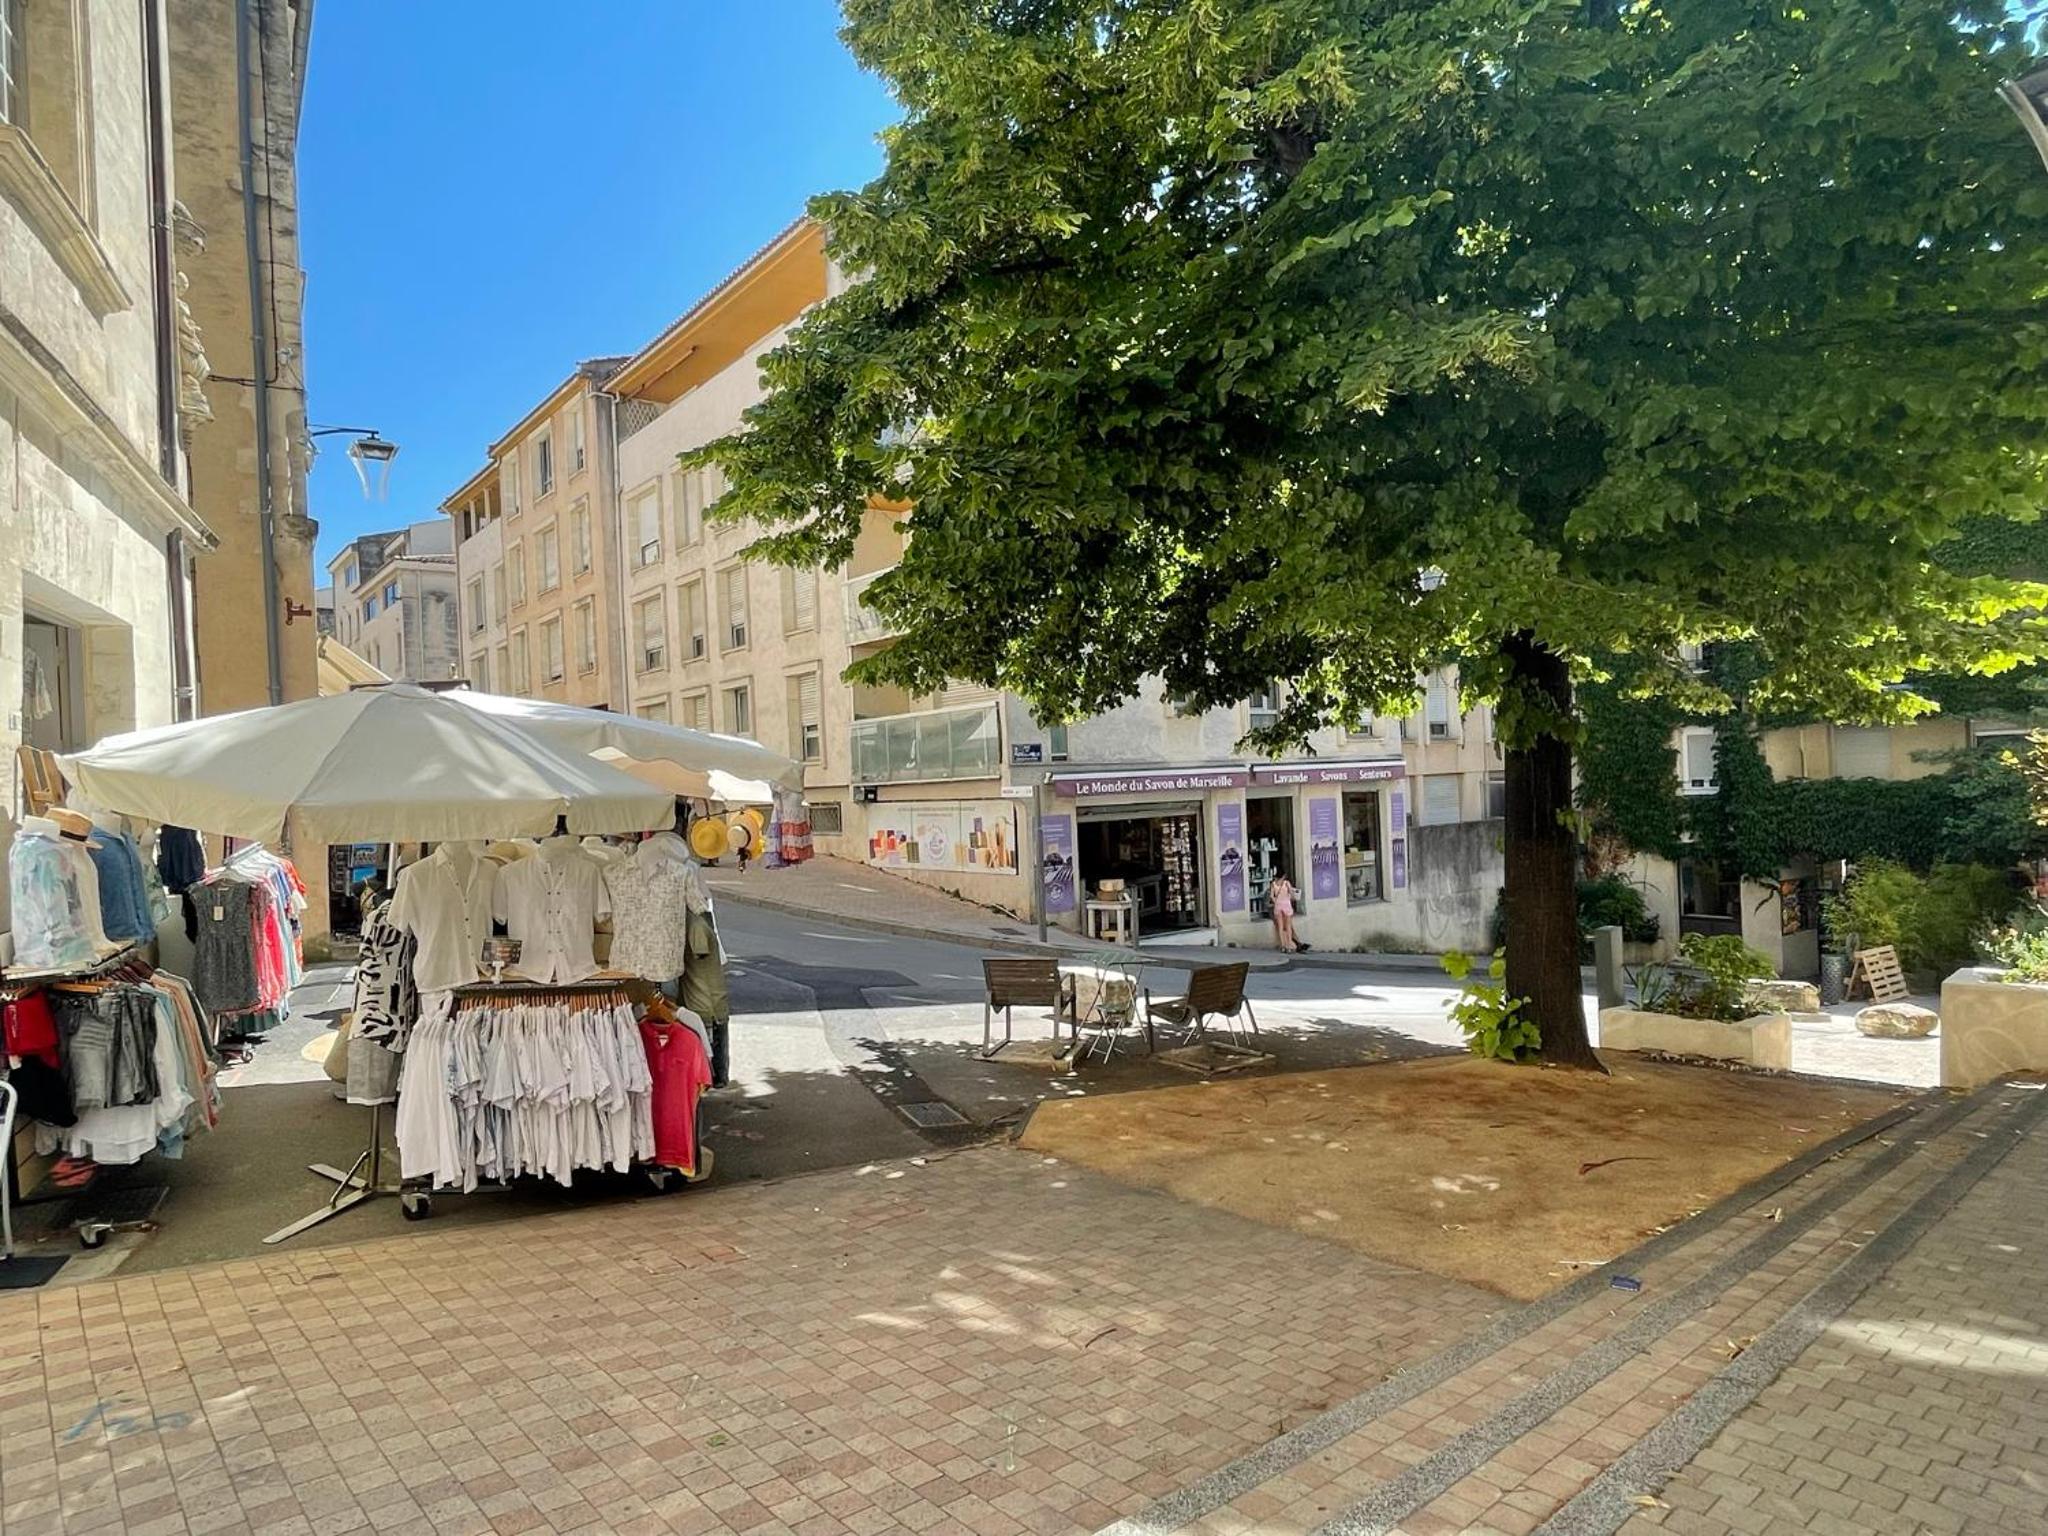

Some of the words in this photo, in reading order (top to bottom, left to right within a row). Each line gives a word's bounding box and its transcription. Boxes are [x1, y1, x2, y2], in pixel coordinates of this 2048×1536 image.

[1273, 772, 1308, 784] Lavande
[1321, 771, 1347, 781] Savons
[1360, 769, 1391, 779] Senteurs
[1076, 782, 1089, 794] Le
[1091, 780, 1127, 793] Monde
[1129, 779, 1143, 791] du
[1145, 779, 1175, 790] Savon
[1176, 777, 1188, 788] de
[1190, 776, 1232, 787] Marseille
